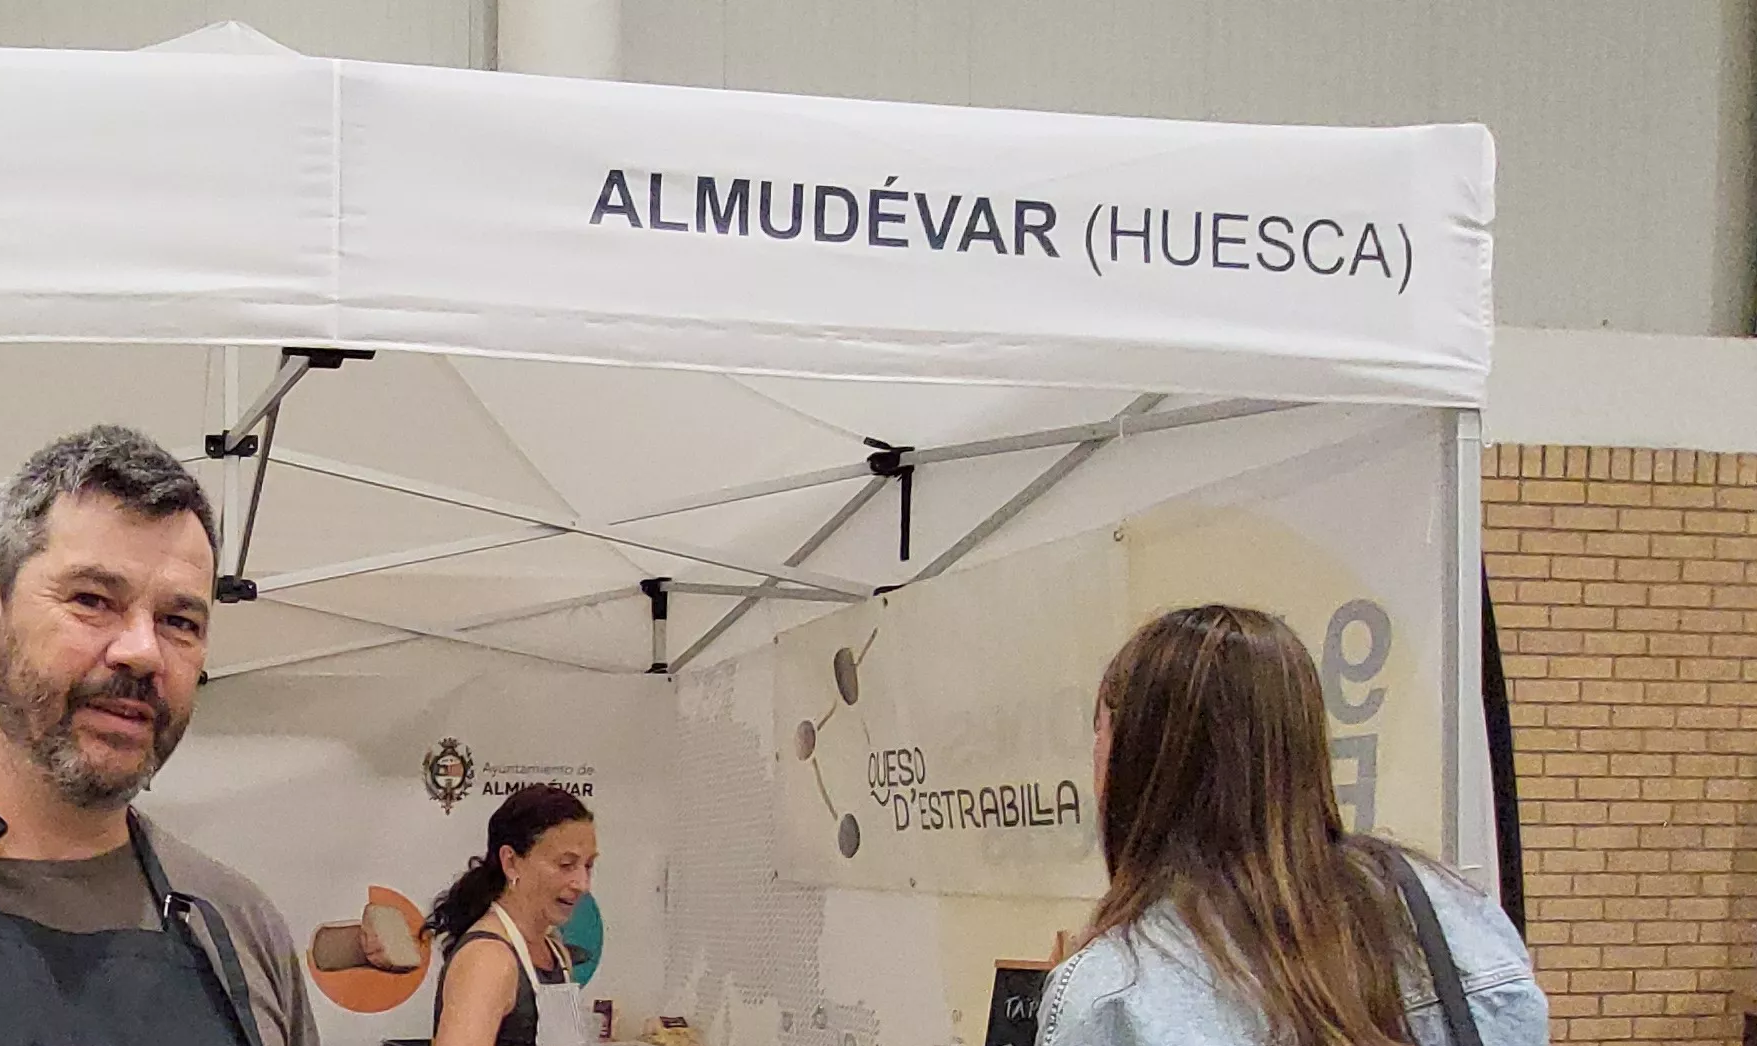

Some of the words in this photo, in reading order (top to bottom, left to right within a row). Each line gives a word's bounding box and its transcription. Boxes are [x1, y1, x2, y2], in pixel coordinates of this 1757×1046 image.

[588, 168, 1061, 259] ALMUDÉVAR
[1083, 202, 1414, 294] (HUESCA)
[483, 762, 574, 778] Ayuntamiento
[577, 763, 595, 776] de
[868, 746, 926, 807] QUESO
